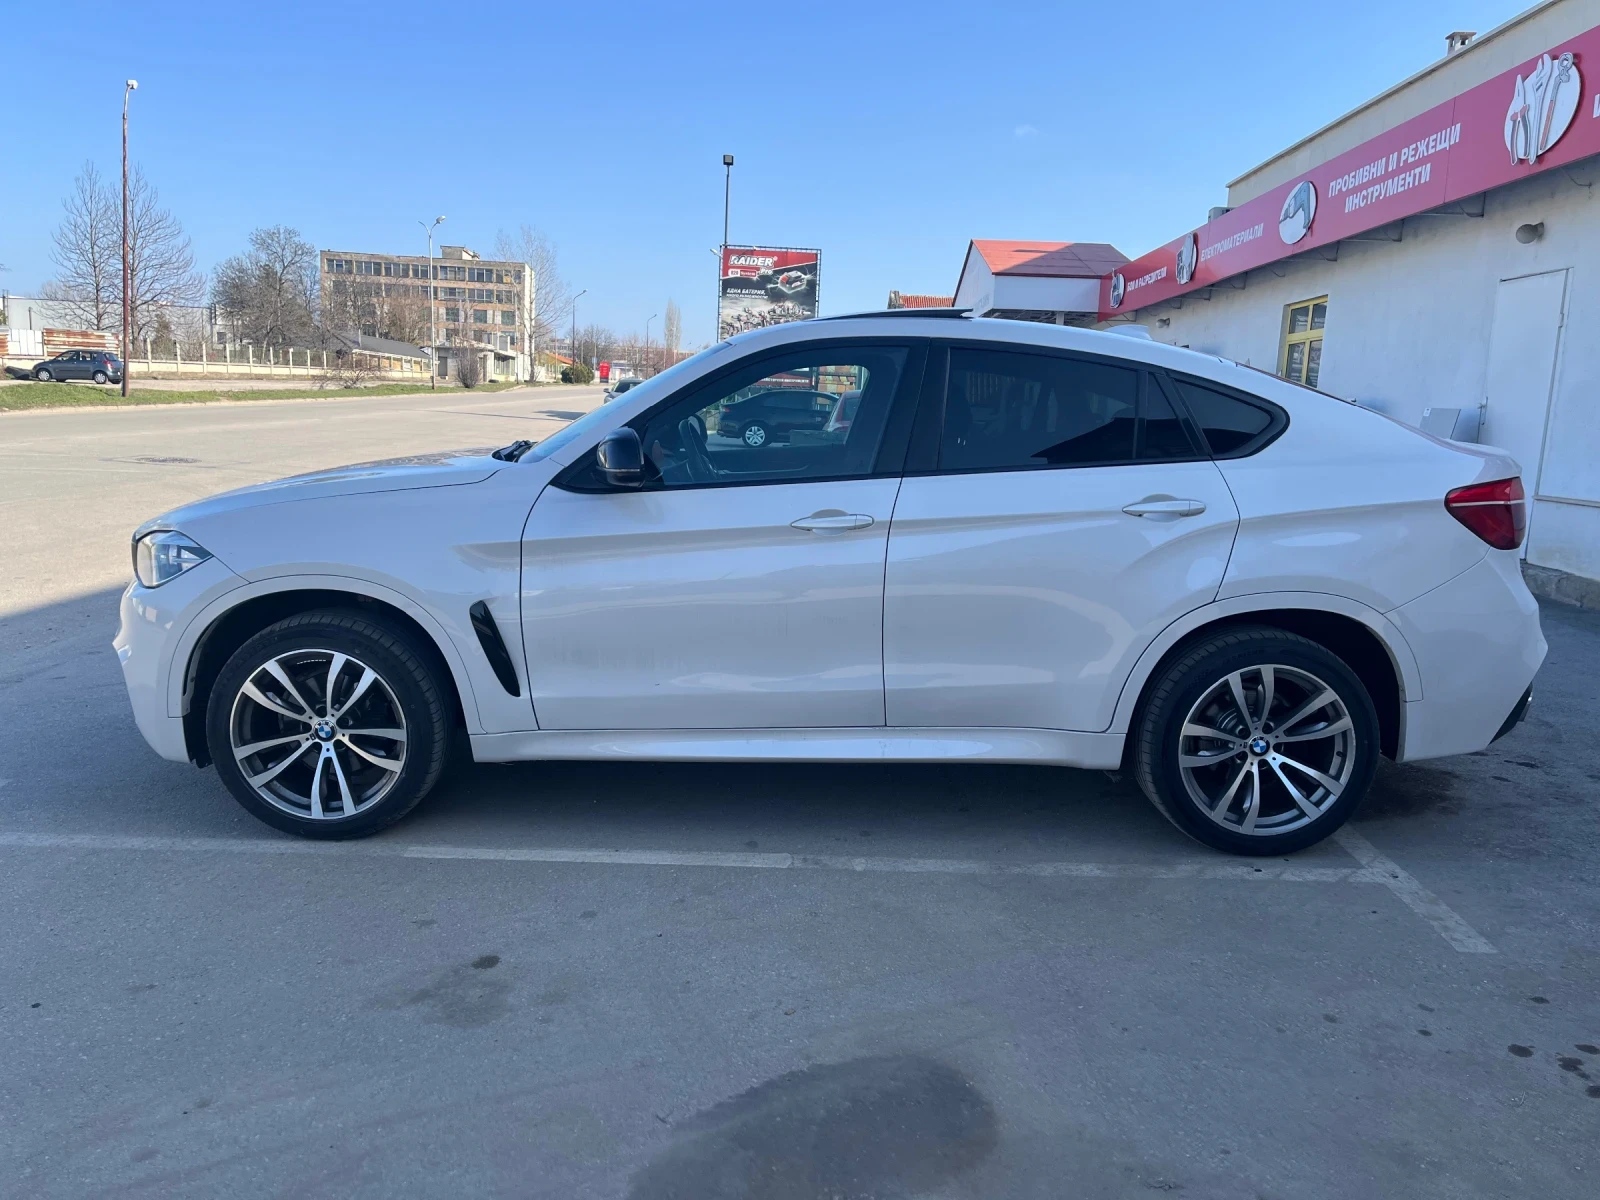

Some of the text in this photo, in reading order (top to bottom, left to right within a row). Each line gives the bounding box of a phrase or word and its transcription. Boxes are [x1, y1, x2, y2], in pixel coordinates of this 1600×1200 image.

[1328, 123, 1462, 198] ПРОБИВНИ И РЕЖЕЩИ
[1344, 163, 1432, 214] ИНСТРУМЕНТИ
[730, 255, 774, 267] RAIDER
[1200, 222, 1265, 262] ЕЛЕКТРОМАТЕРИАЛИ
